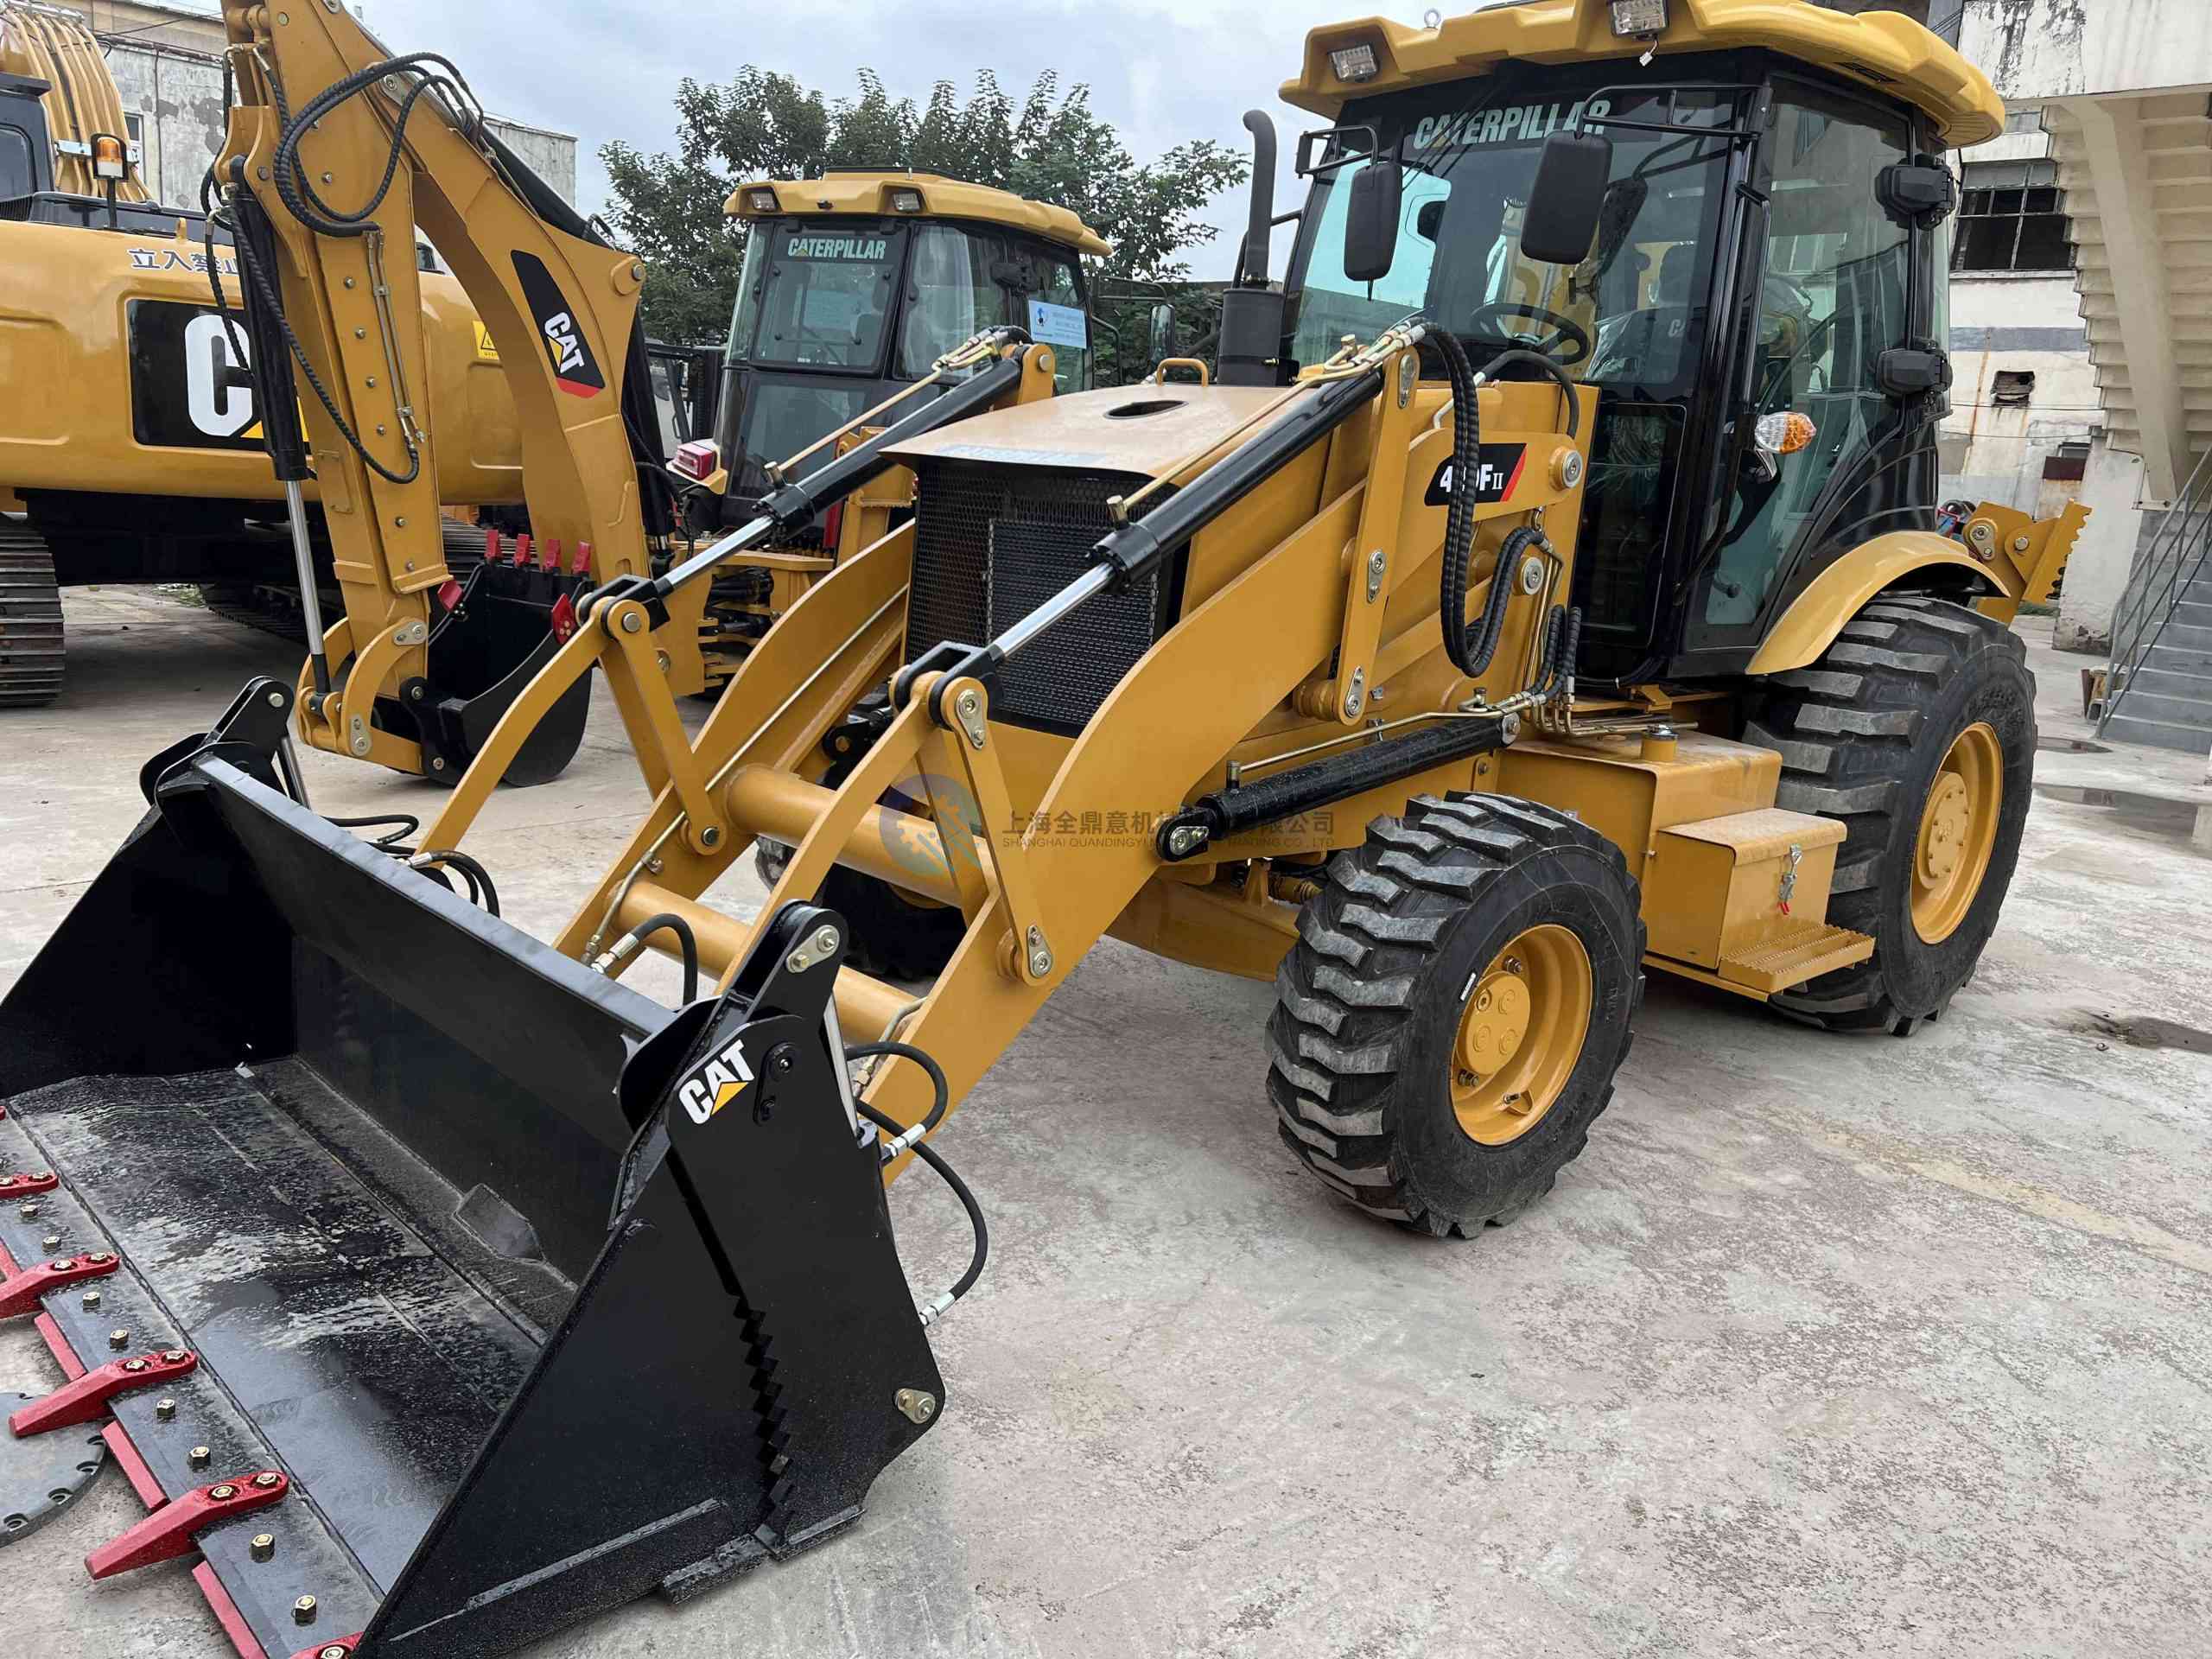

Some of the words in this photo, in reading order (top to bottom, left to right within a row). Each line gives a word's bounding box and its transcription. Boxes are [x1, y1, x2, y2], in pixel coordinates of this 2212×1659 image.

[1413, 100, 1611, 149] CATERPILLAR
[787, 238, 887, 259] CATERPILLAR
[544, 311, 585, 374] CAT
[678, 1039, 755, 1124] CAT
